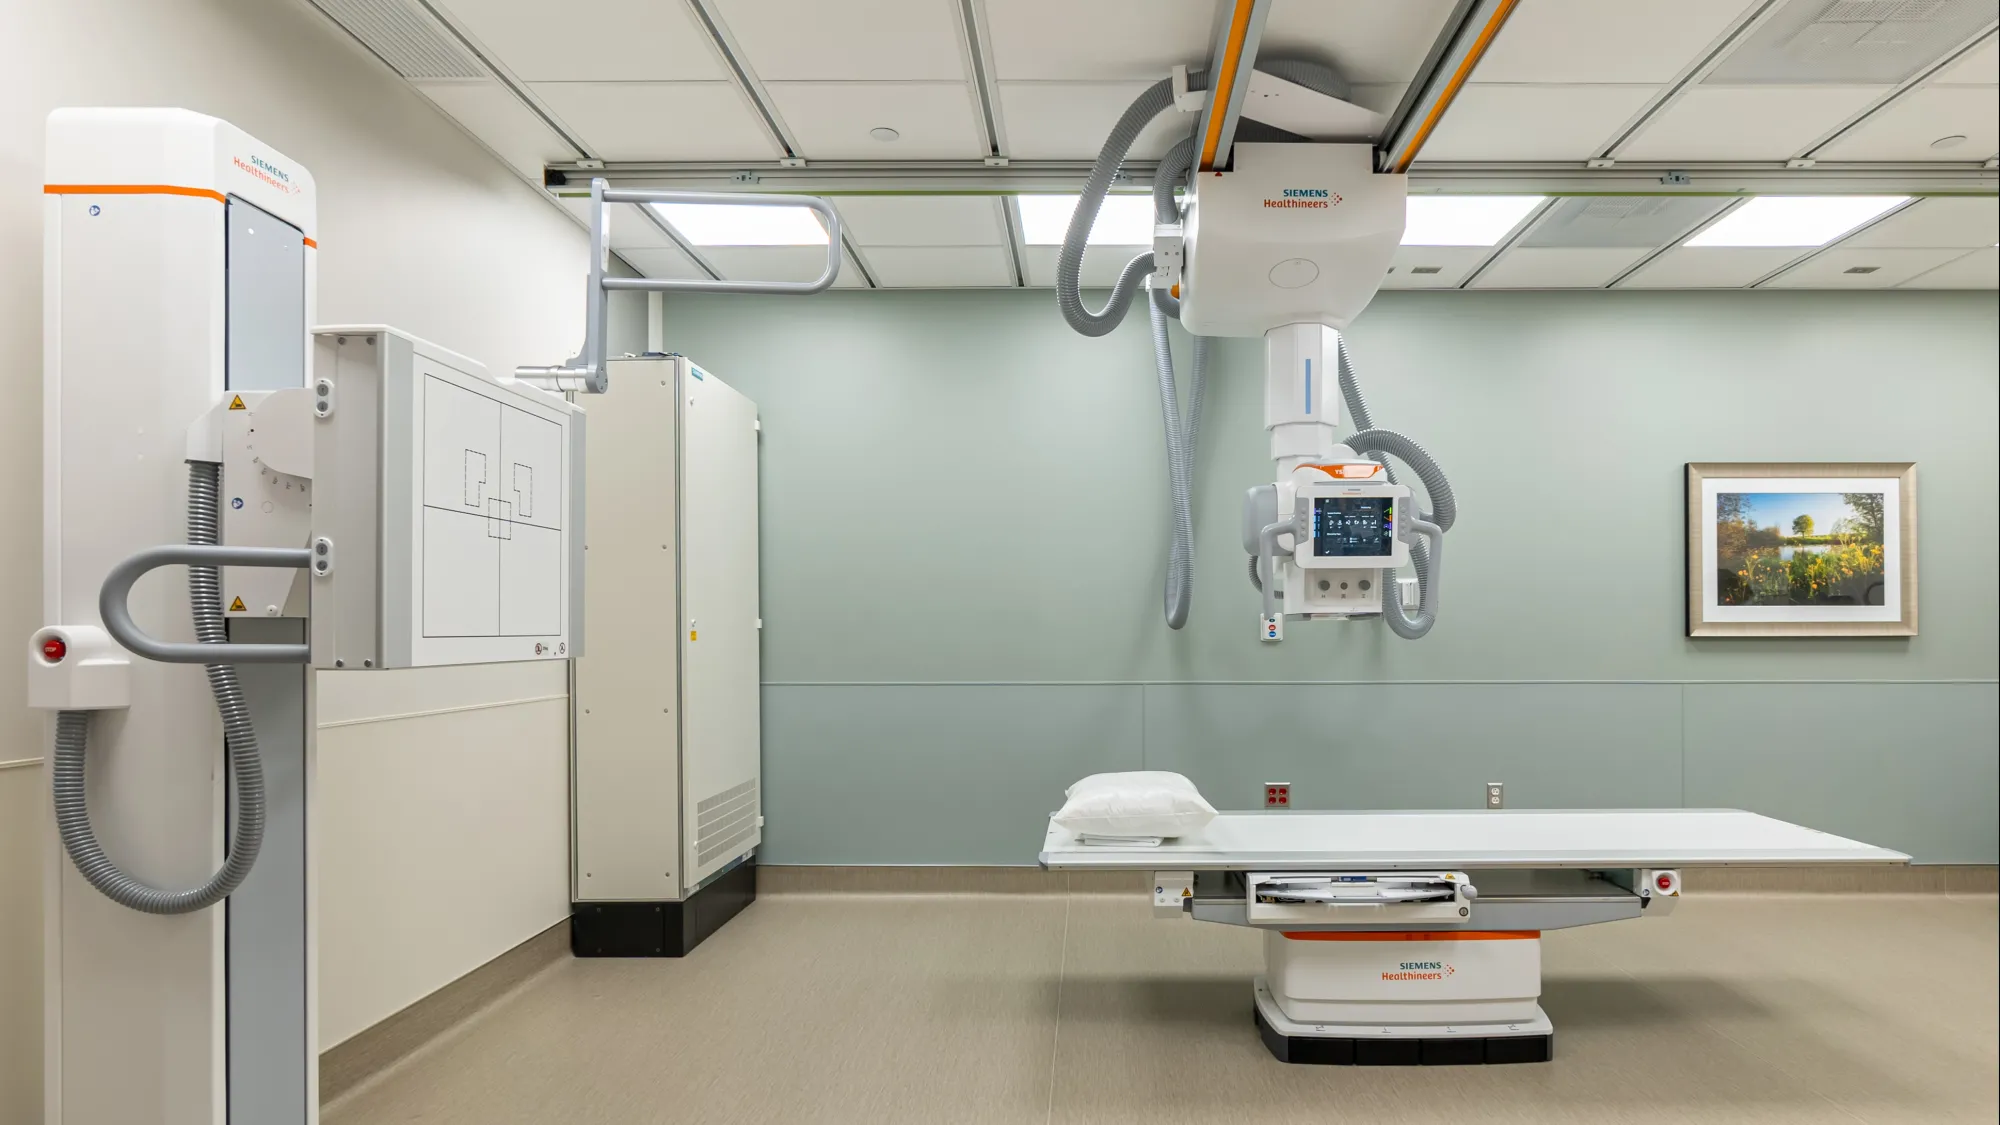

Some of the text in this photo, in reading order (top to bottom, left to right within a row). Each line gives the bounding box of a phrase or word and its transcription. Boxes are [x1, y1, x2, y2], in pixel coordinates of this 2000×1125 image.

[251, 155, 289, 182] SIEMENS
[233, 156, 289, 193] Healthineers
[1283, 189, 1328, 197] SIEMENS
[1263, 199, 1328, 208] Healthineers
[1382, 971, 1442, 980] Healthineers
